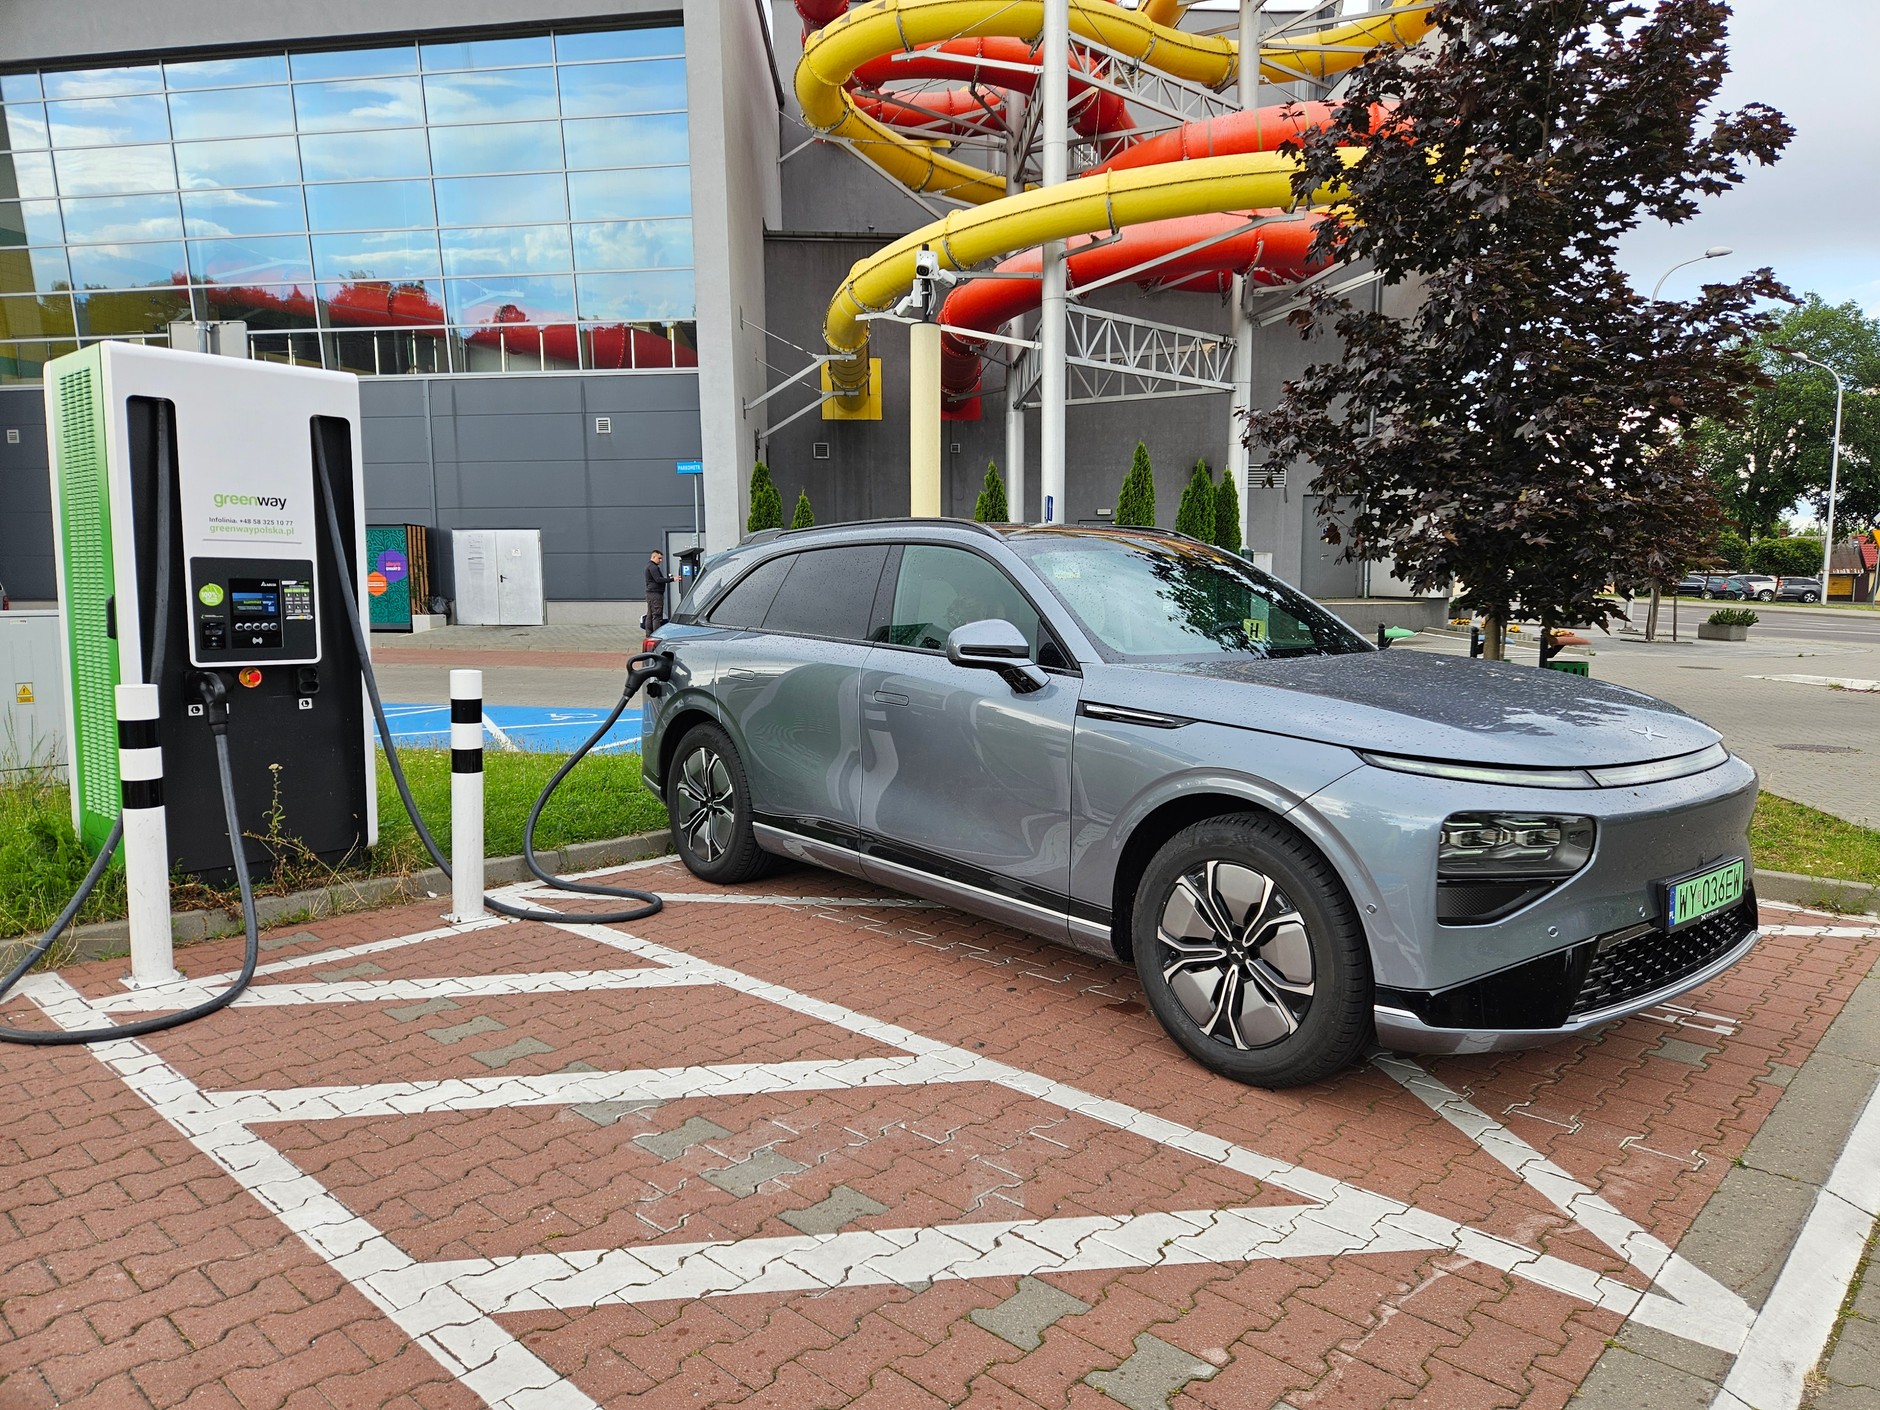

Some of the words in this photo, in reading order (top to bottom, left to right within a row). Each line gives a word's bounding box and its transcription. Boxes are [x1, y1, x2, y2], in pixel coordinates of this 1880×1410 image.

[213, 493, 287, 510] greenway
[209, 525, 294, 536] greenwaypolska.pl
[683, 565, 689, 574] P
[1249, 622, 1259, 638] H
[1668, 911, 1675, 920] PL
[1679, 883, 1698, 919] WY
[1702, 866, 1741, 909] 036EW
